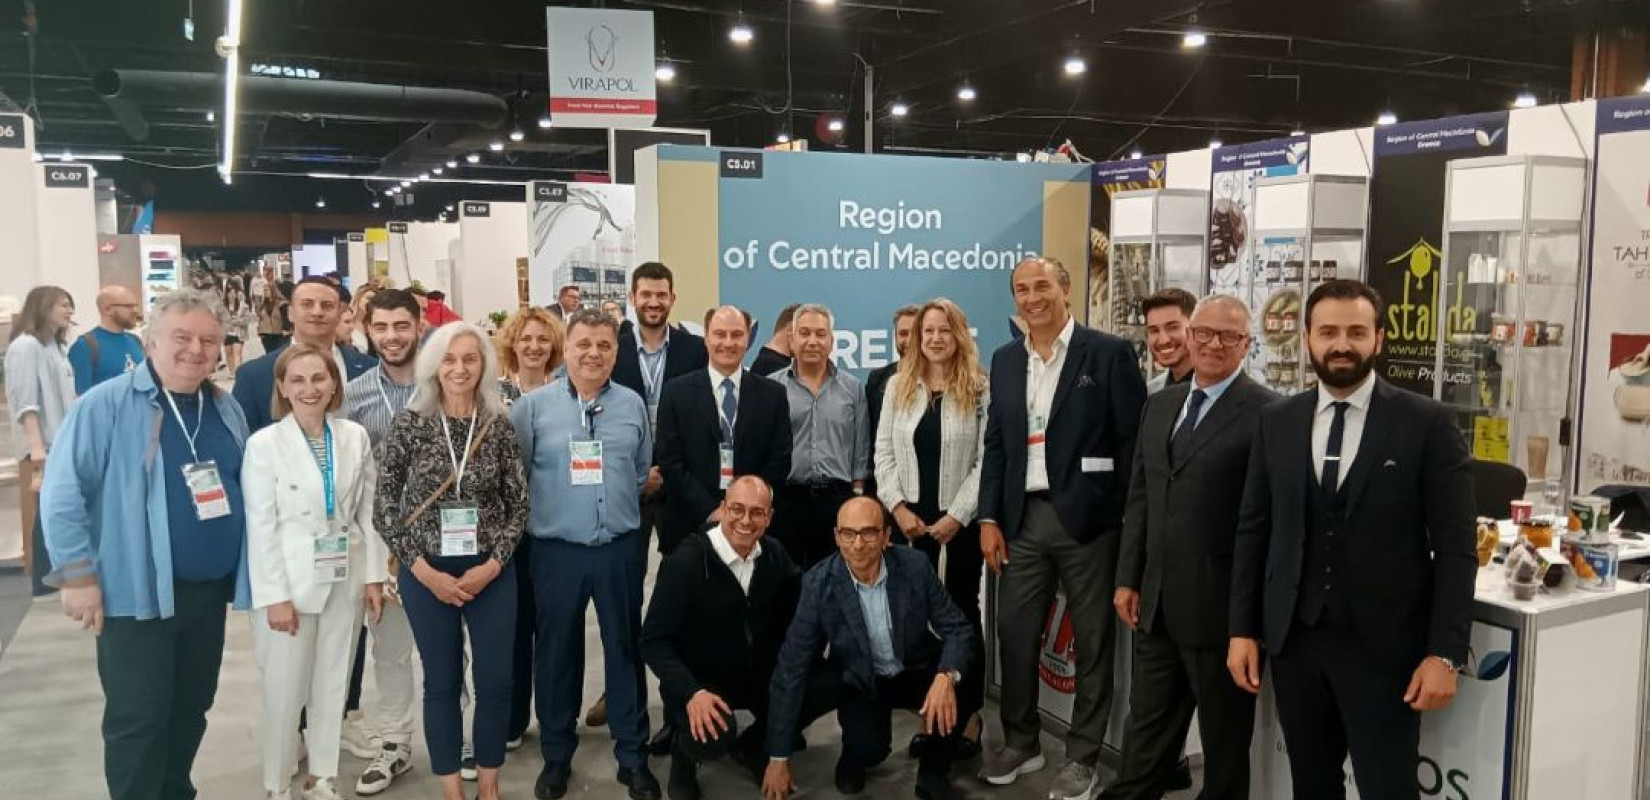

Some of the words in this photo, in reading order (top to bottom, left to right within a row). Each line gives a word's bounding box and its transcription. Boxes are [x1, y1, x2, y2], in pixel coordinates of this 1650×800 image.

[568, 76, 640, 92] VIRAPOL
[727, 159, 756, 170] C5.01
[839, 200, 942, 234] Region
[723, 240, 759, 269] of
[768, 241, 880, 270] Central
[1387, 270, 1477, 341] stalda
[1388, 365, 1415, 378] Olive
